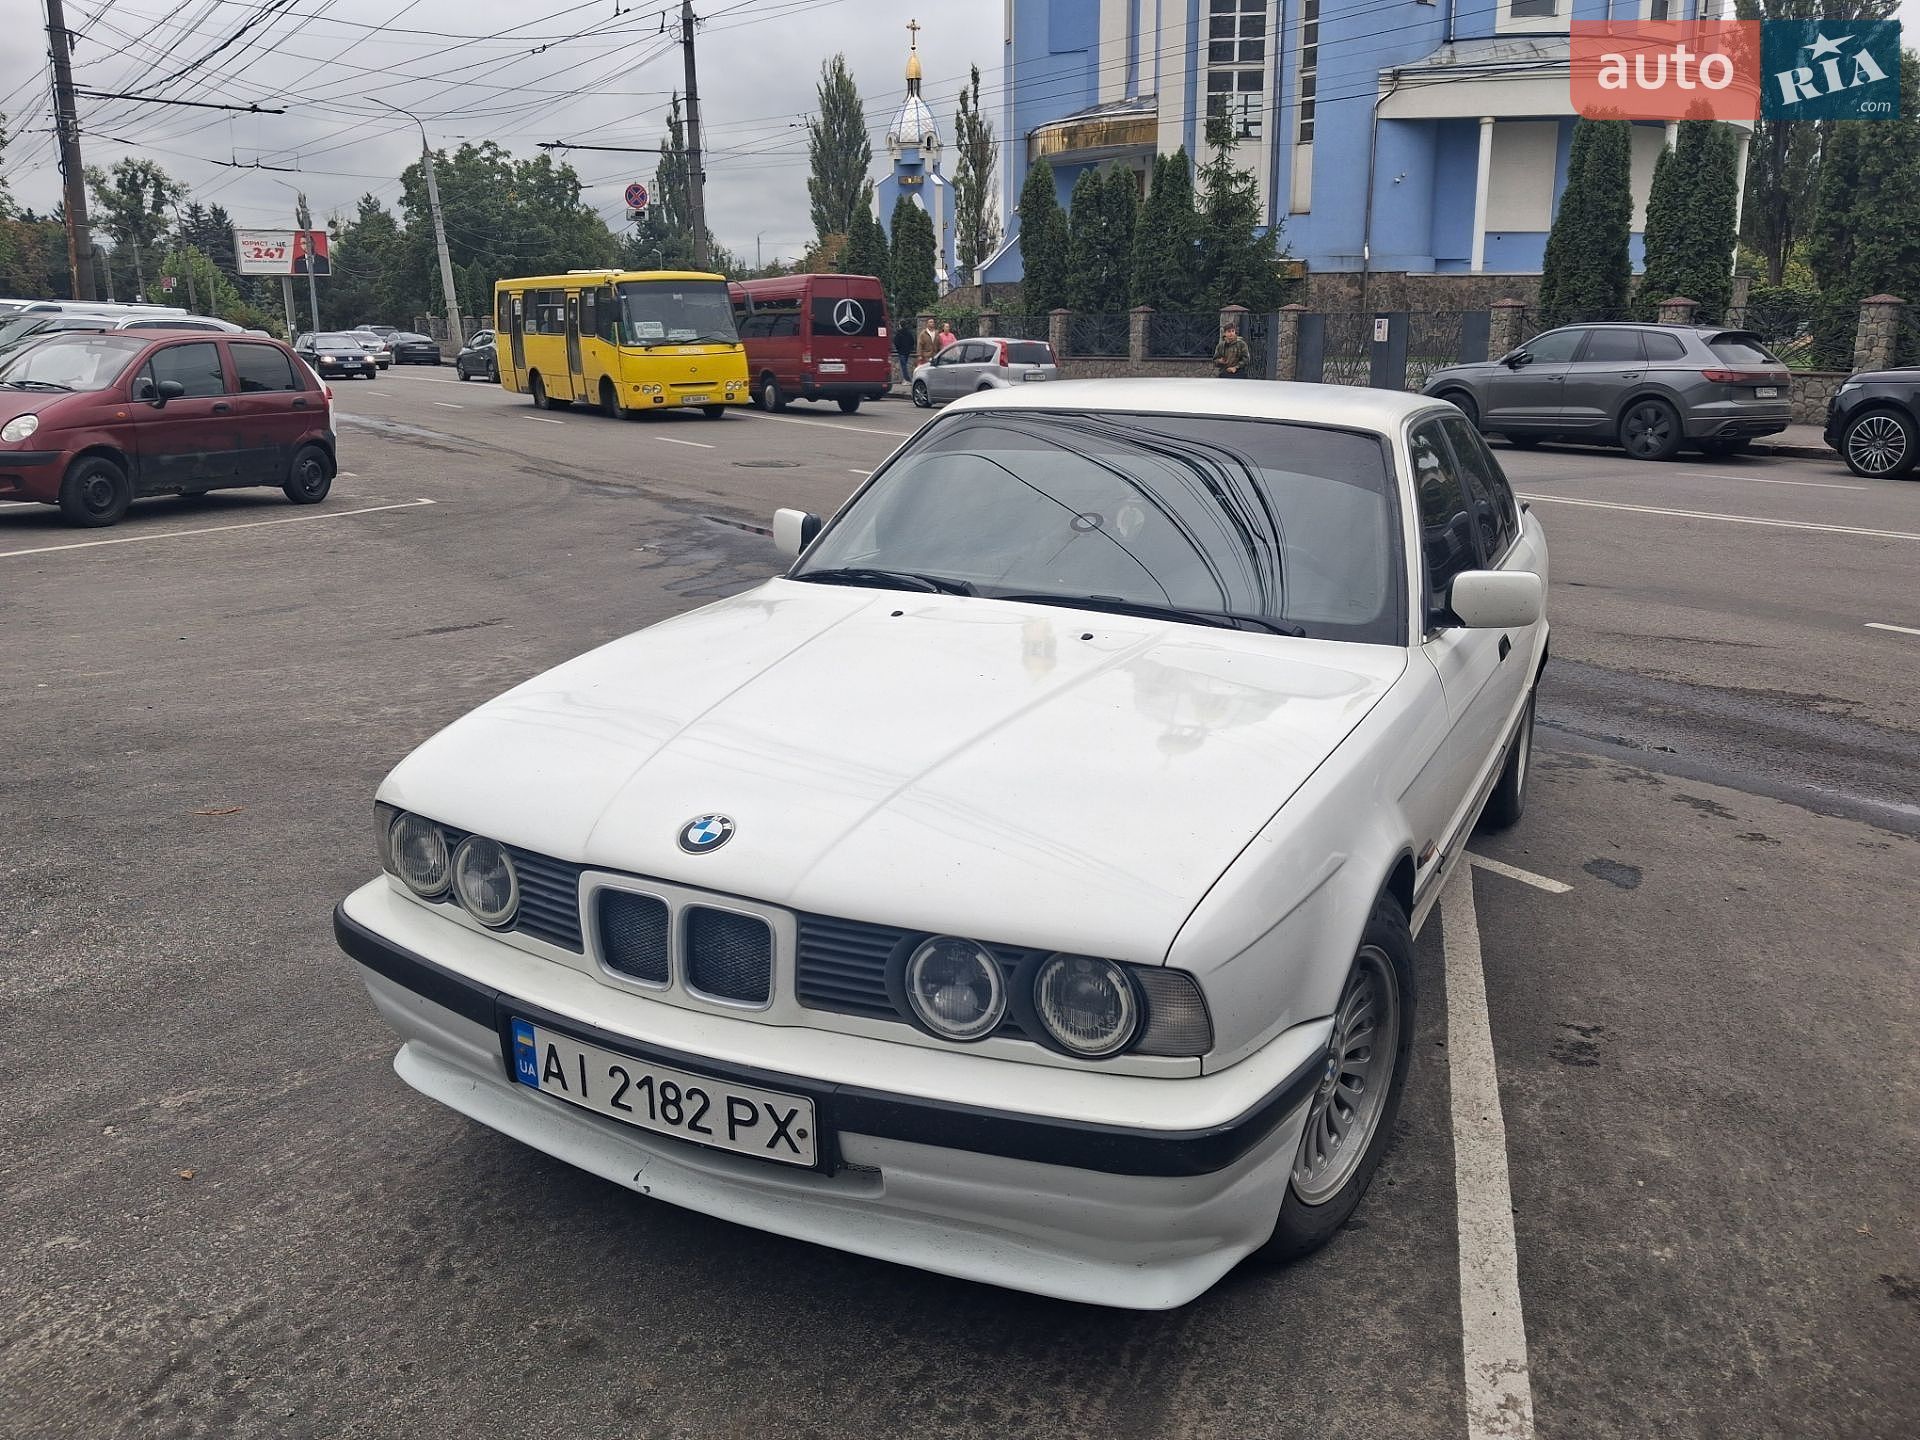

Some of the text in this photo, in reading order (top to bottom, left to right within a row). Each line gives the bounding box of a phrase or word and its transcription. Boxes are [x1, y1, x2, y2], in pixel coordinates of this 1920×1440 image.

[253, 247, 285, 258] 247
[519, 1060, 536, 1077] UA
[542, 1043, 801, 1153] AI 2182 PX
